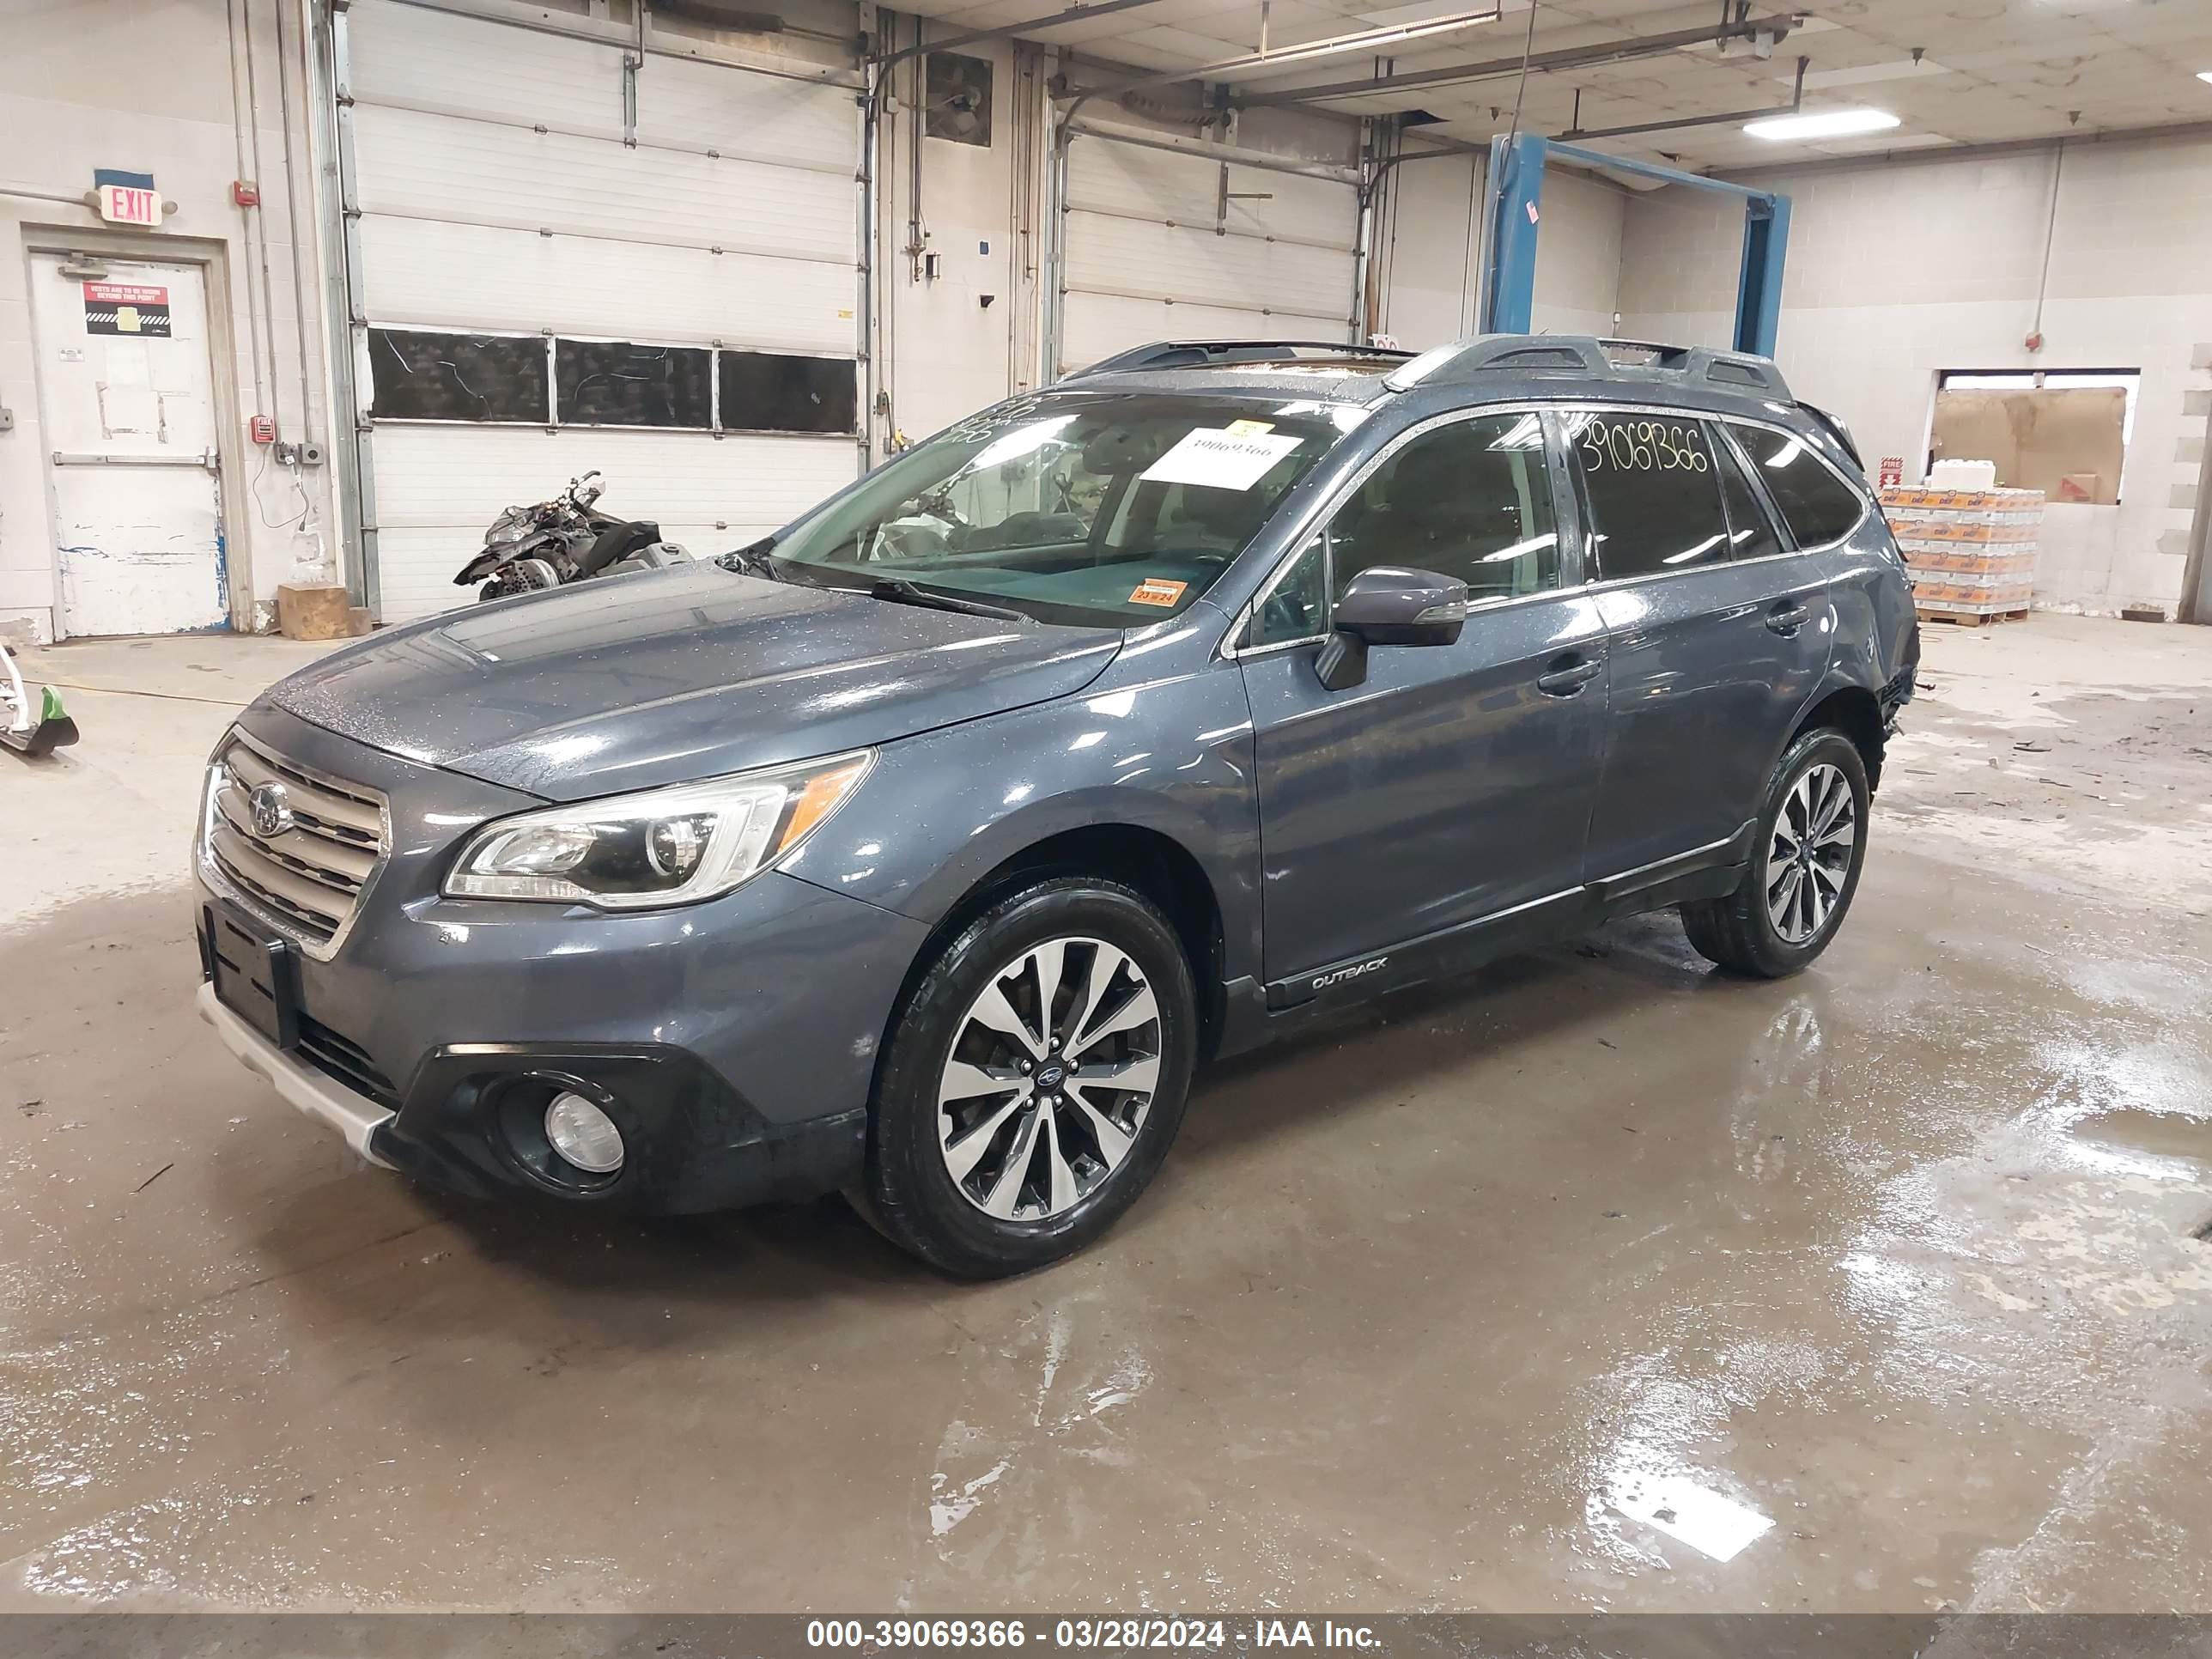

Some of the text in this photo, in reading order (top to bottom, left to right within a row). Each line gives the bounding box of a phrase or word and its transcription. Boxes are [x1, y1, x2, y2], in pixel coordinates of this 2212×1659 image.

[112, 189, 154, 222] EXIT
[1583, 420, 1708, 472] 39069366
[1312, 957, 1388, 989] OUTBACK
